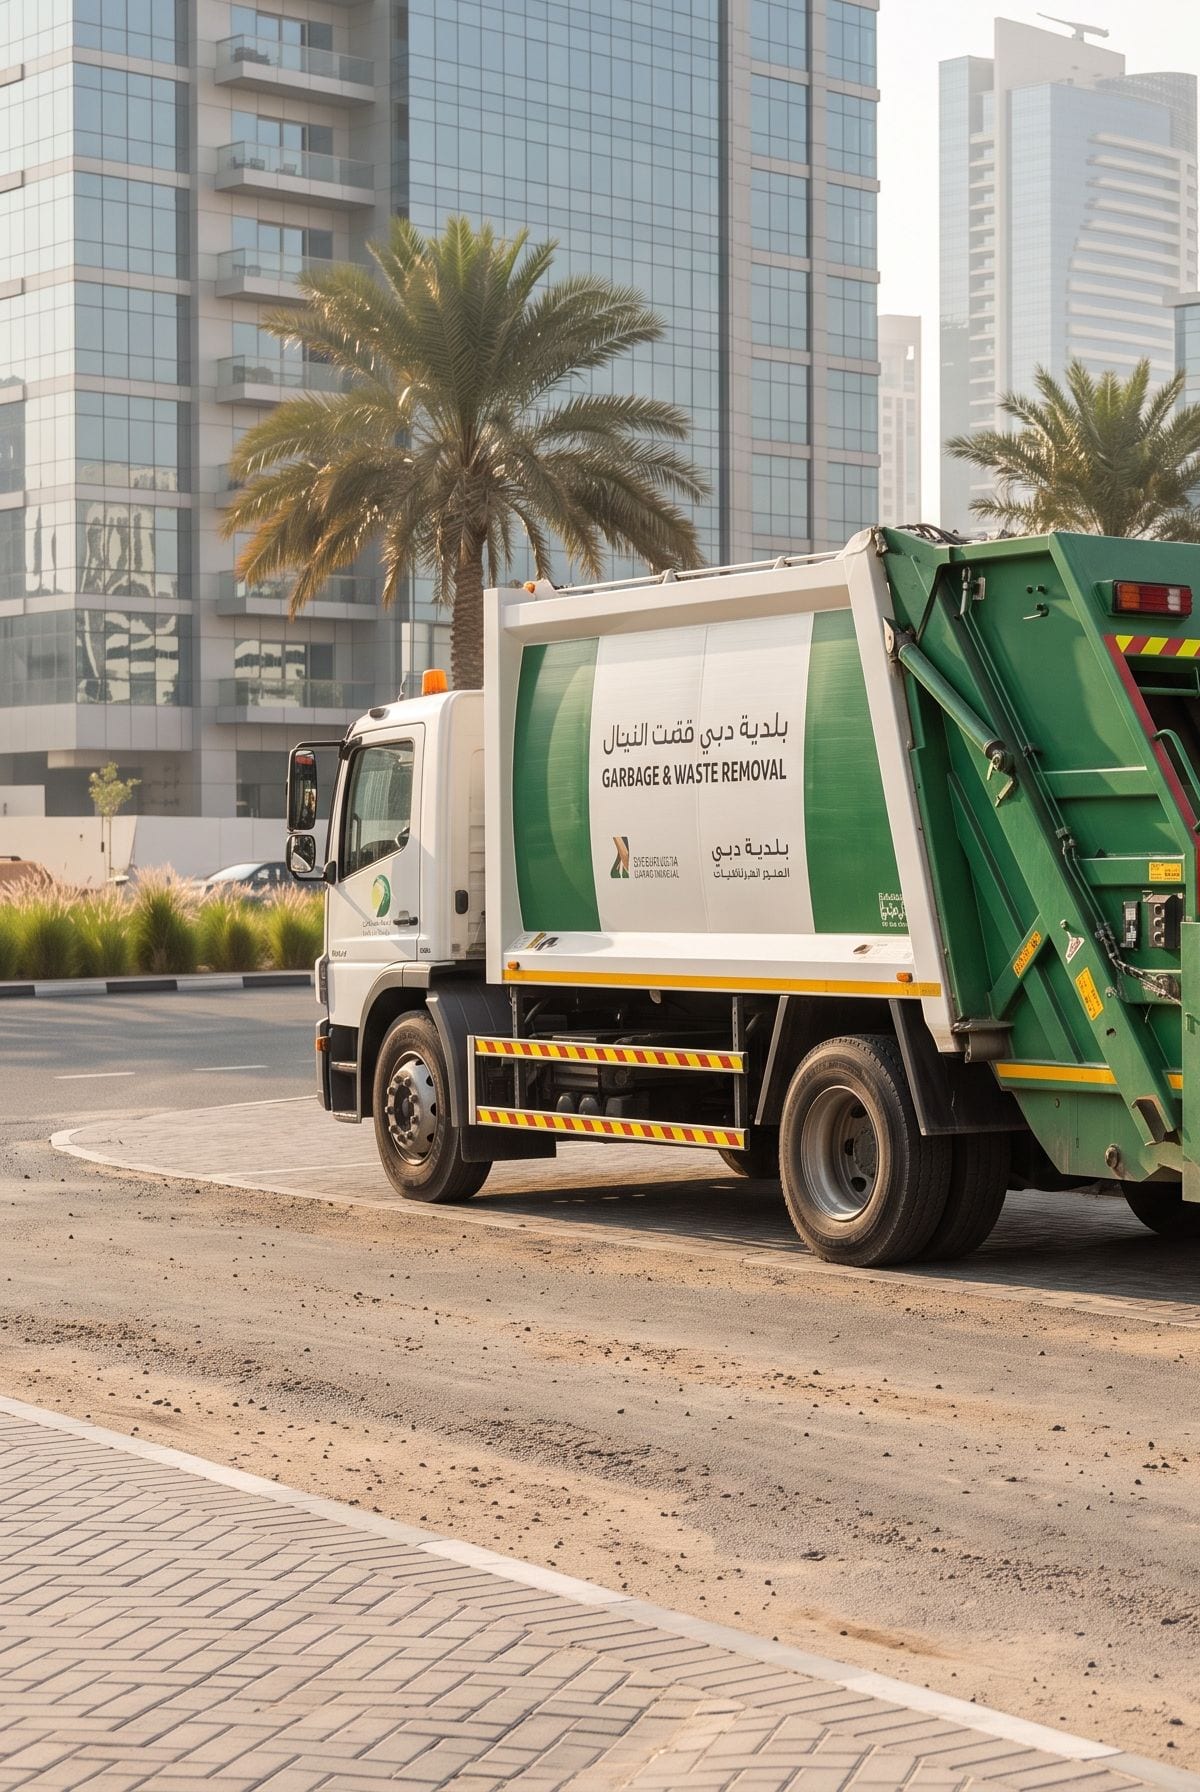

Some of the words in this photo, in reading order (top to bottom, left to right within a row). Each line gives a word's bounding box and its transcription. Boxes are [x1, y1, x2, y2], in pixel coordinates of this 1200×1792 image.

[700, 723, 734, 755] دبي
[739, 711, 789, 746] بلدية
[602, 765, 660, 788] GARBAGE
[662, 765, 672, 785] &
[674, 762, 718, 784] WASTE
[722, 758, 787, 783] REMOVAL
[711, 844, 741, 867] دبي
[745, 837, 789, 860] بلدية
